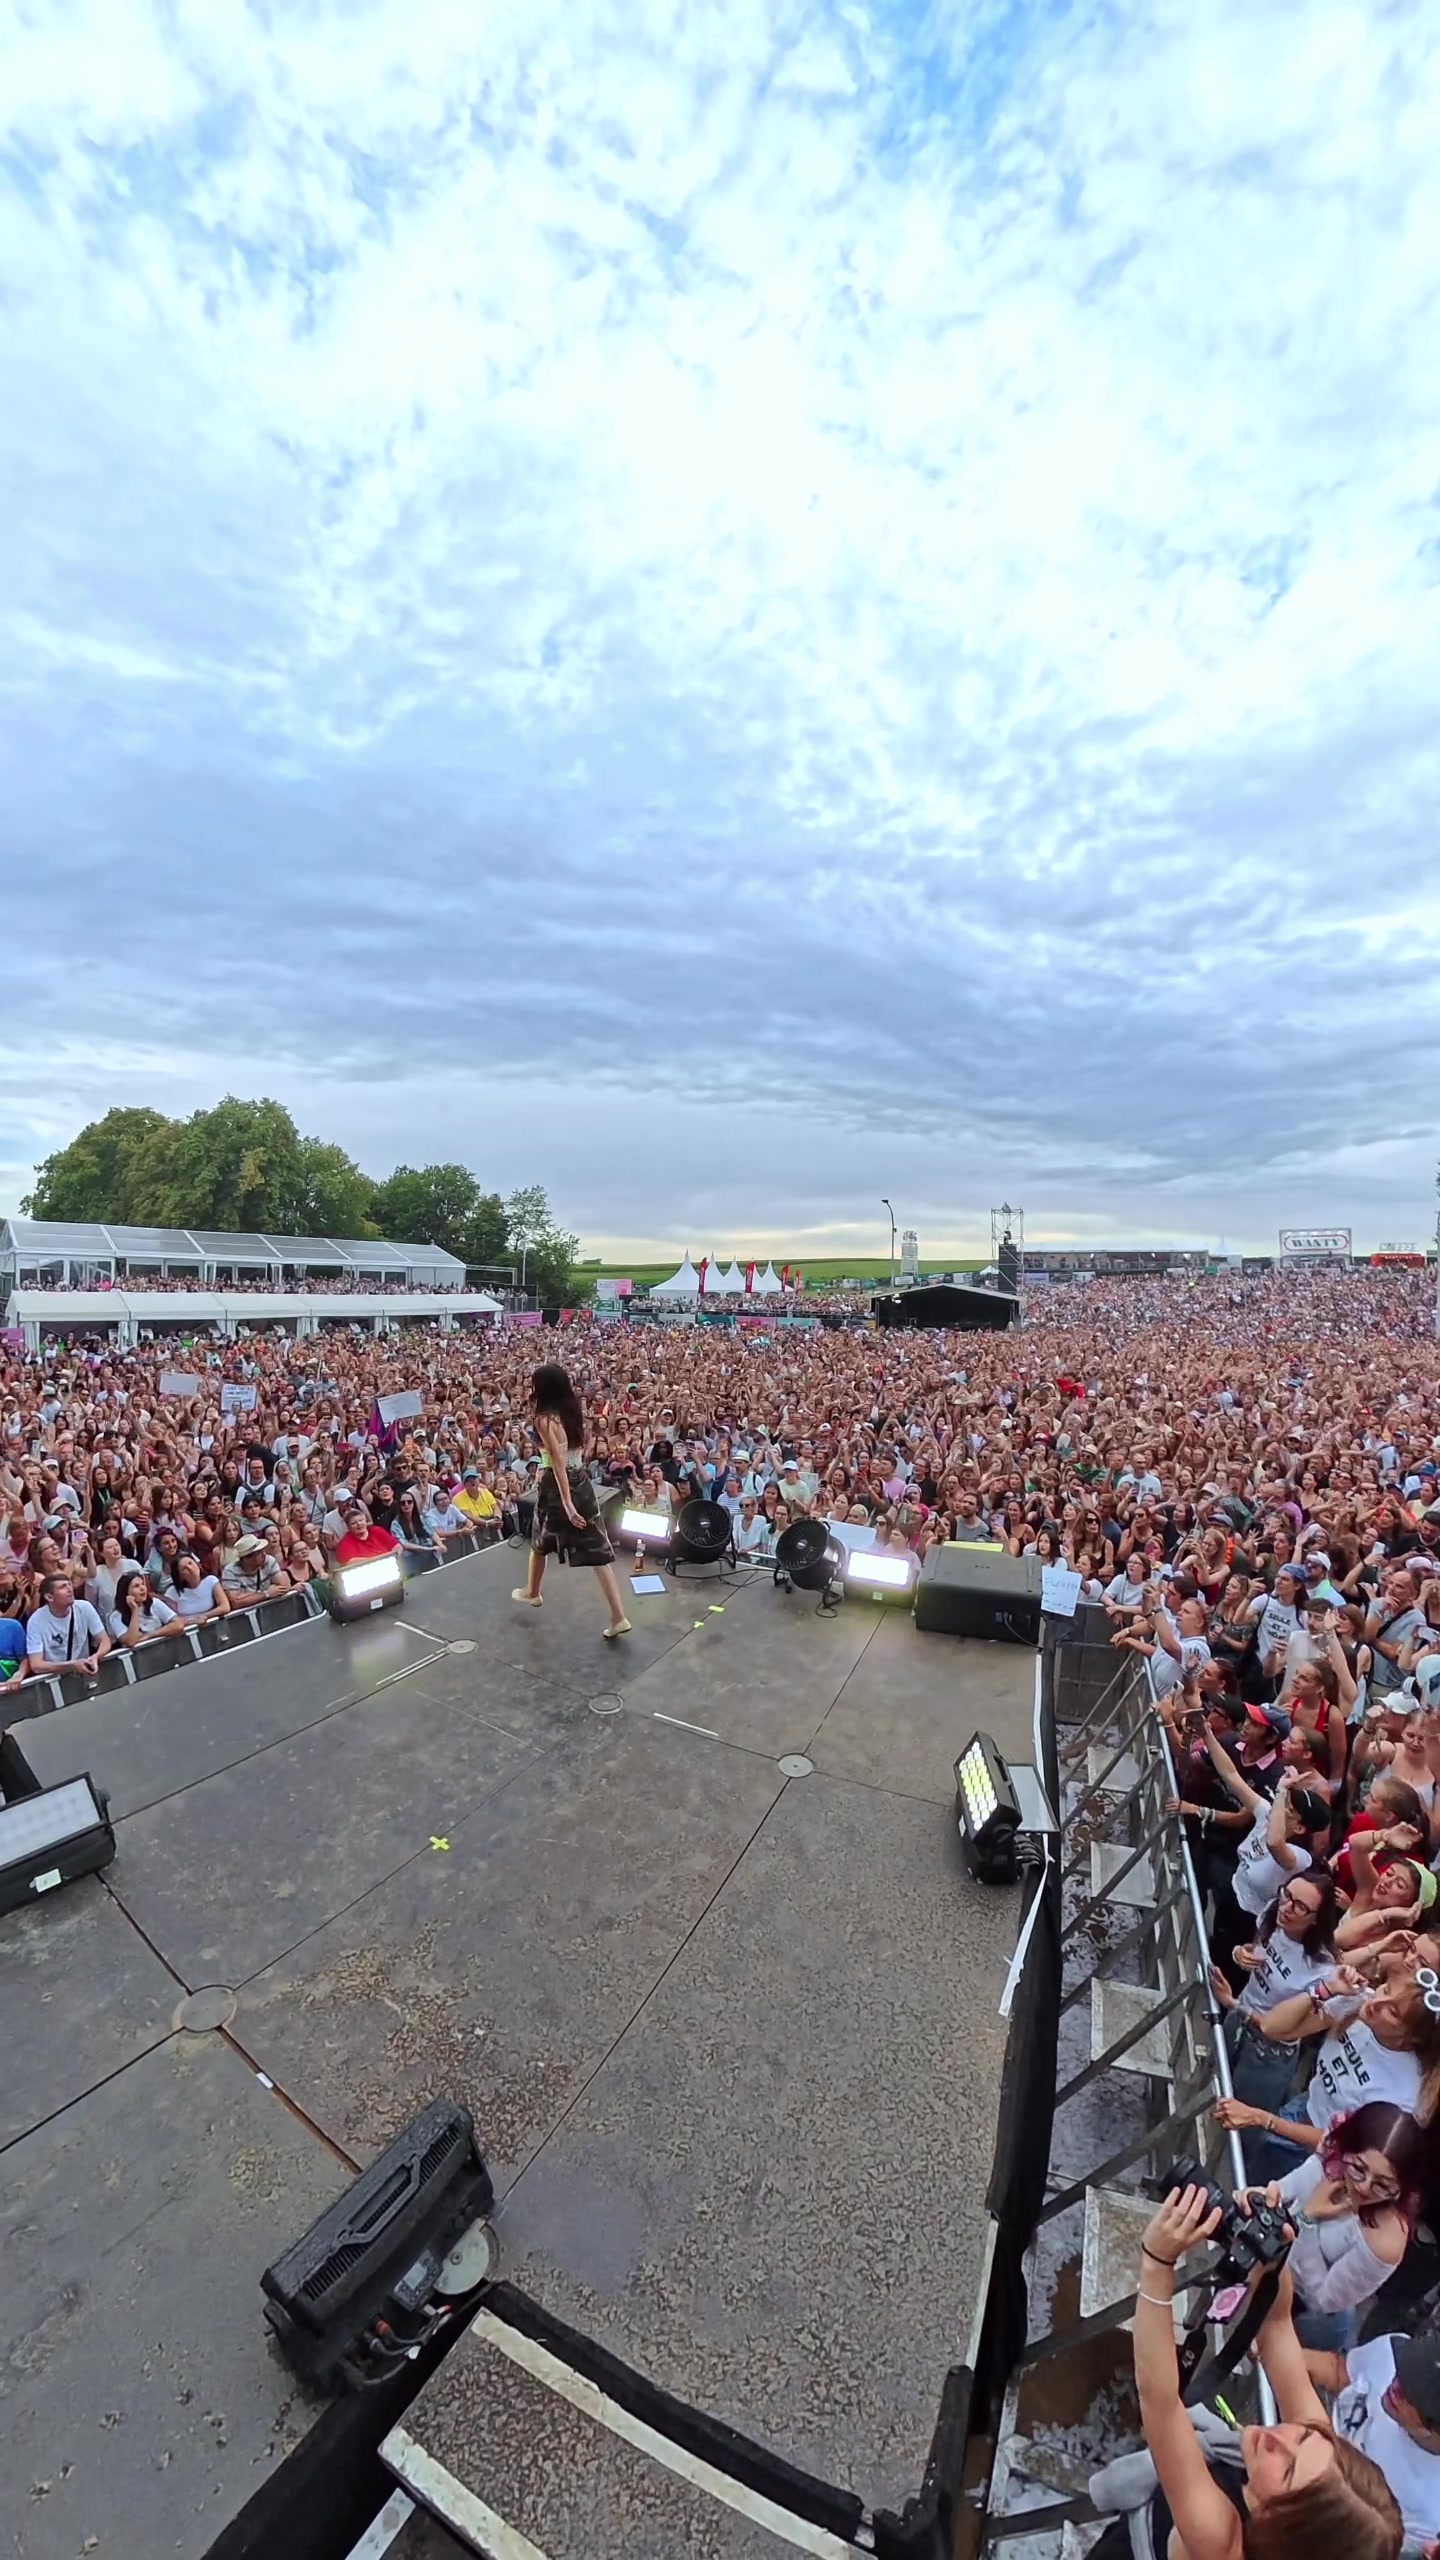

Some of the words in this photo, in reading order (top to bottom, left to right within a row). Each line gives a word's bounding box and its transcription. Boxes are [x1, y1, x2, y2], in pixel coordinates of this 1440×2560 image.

[1316, 2058, 1337, 2096] HOT
[1331, 2056, 1349, 2077] ET
[1338, 2031, 1371, 2086] SEULE
